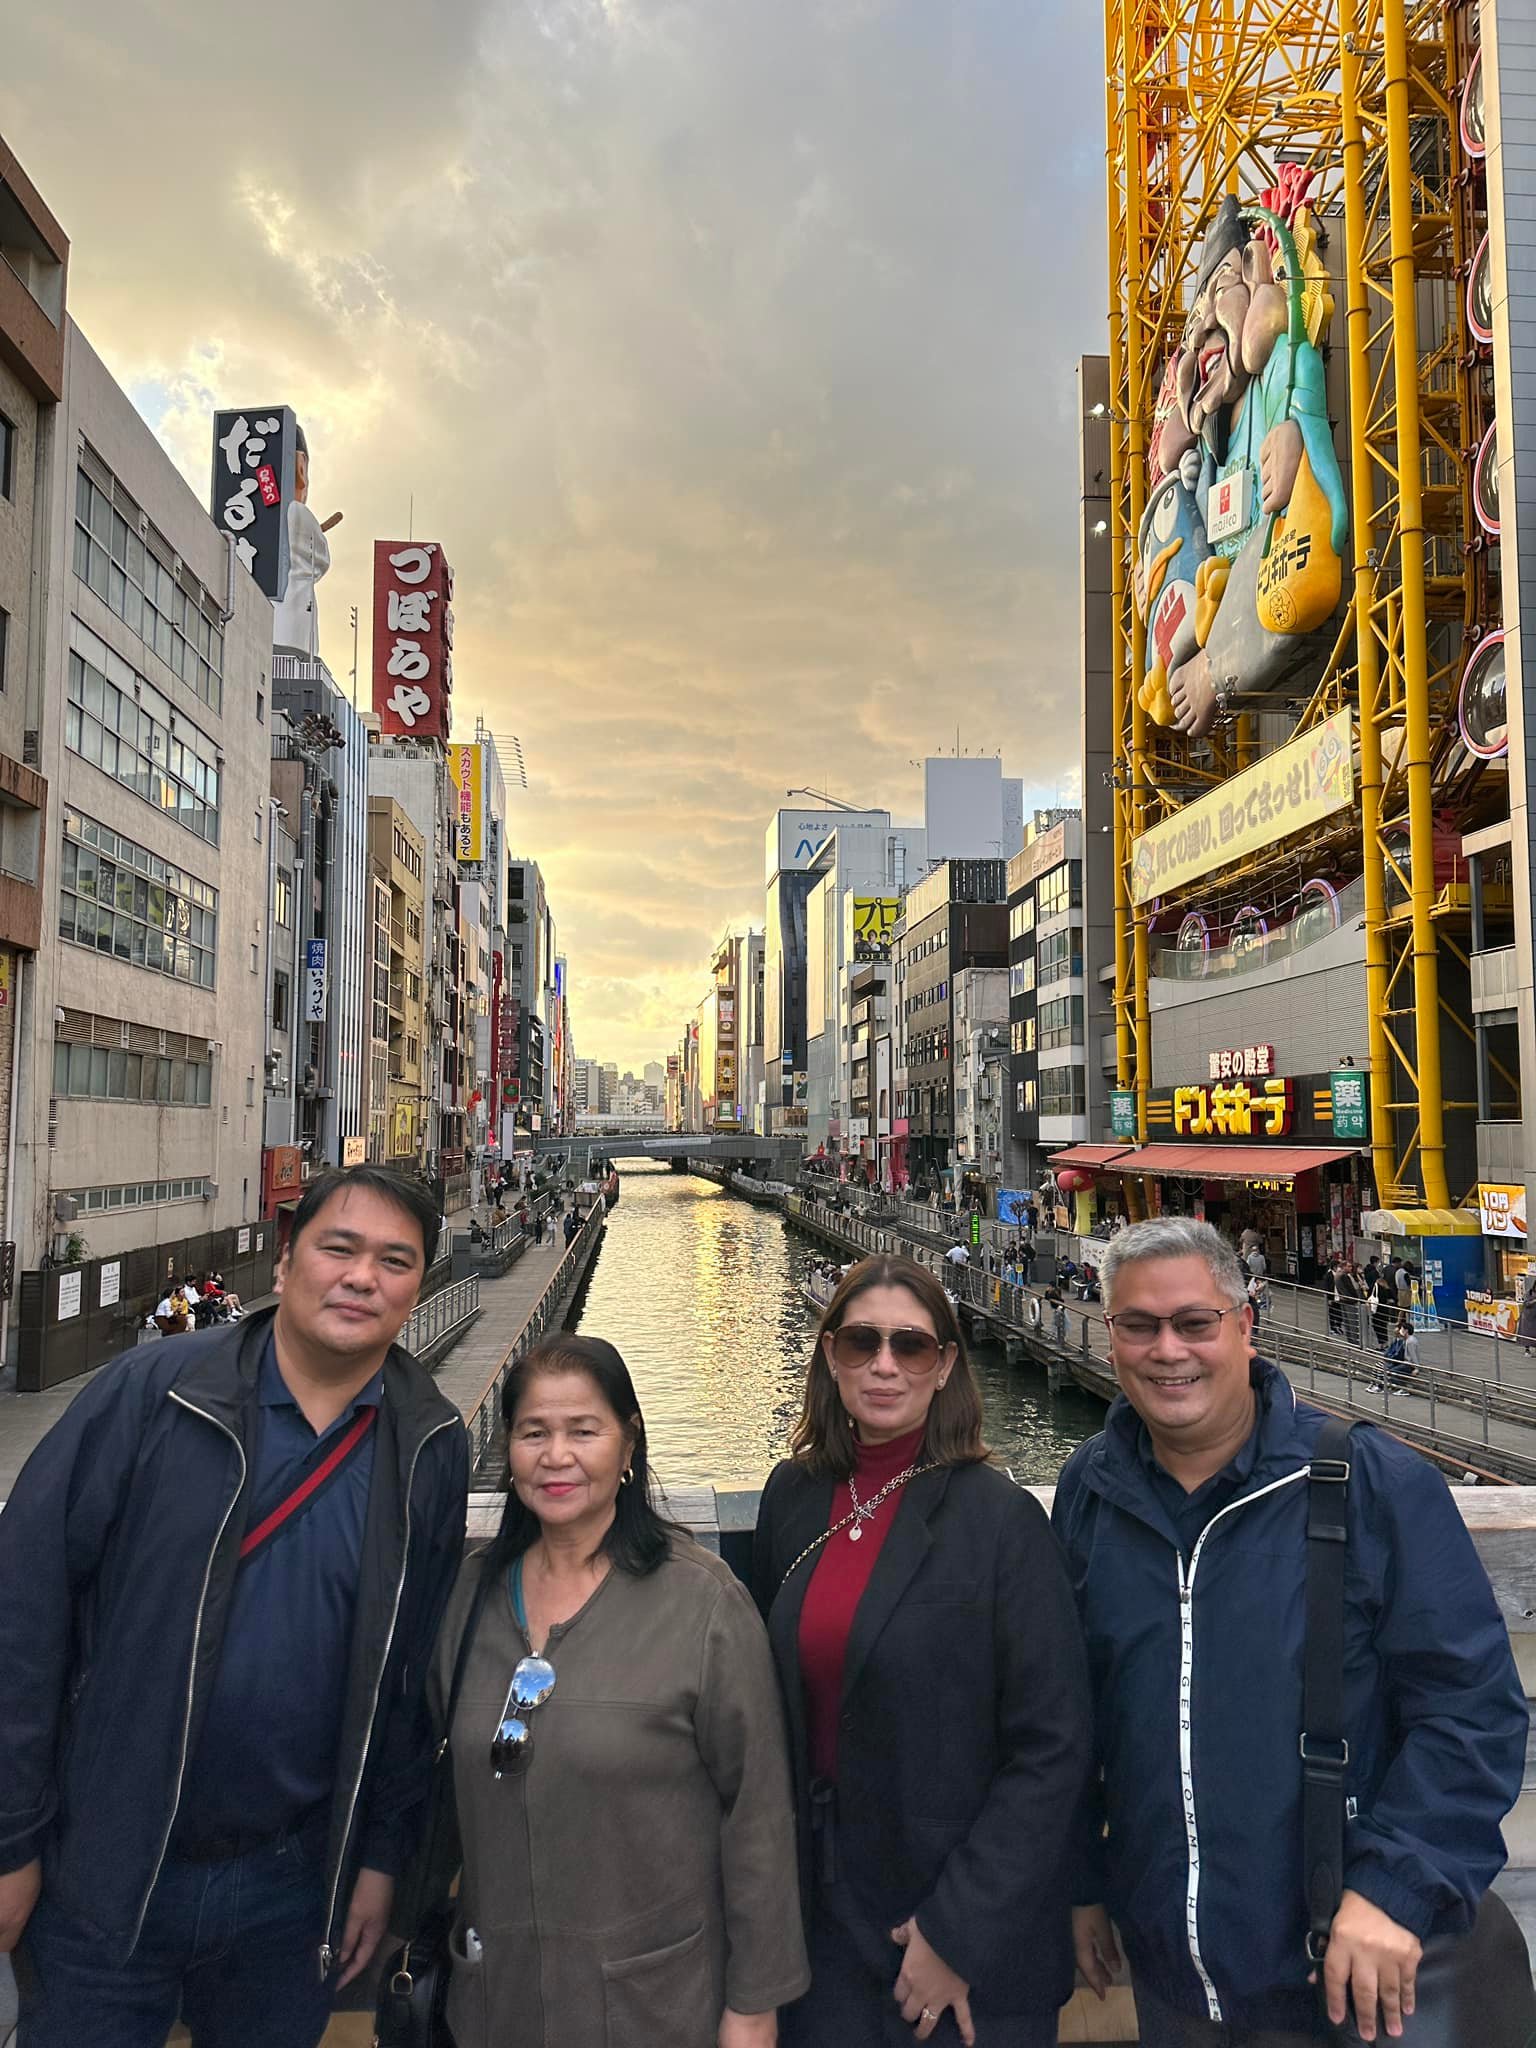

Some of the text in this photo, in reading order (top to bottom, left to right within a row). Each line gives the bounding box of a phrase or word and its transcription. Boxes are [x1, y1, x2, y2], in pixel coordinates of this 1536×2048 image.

[387, 544, 438, 727] づぼらや
[460, 747, 472, 856] スカウト機能もあるて
[311, 942, 324, 968] 焼肉
[311, 970, 323, 1019] いろりや
[1209, 1045, 1271, 1079] 驚安の殿堂
[1113, 1097, 1132, 1116] 薬
[1334, 1080, 1362, 1107] 薬
[1482, 1191, 1509, 1210] 10円
[1182, 1769, 1199, 1870] TOMMY
